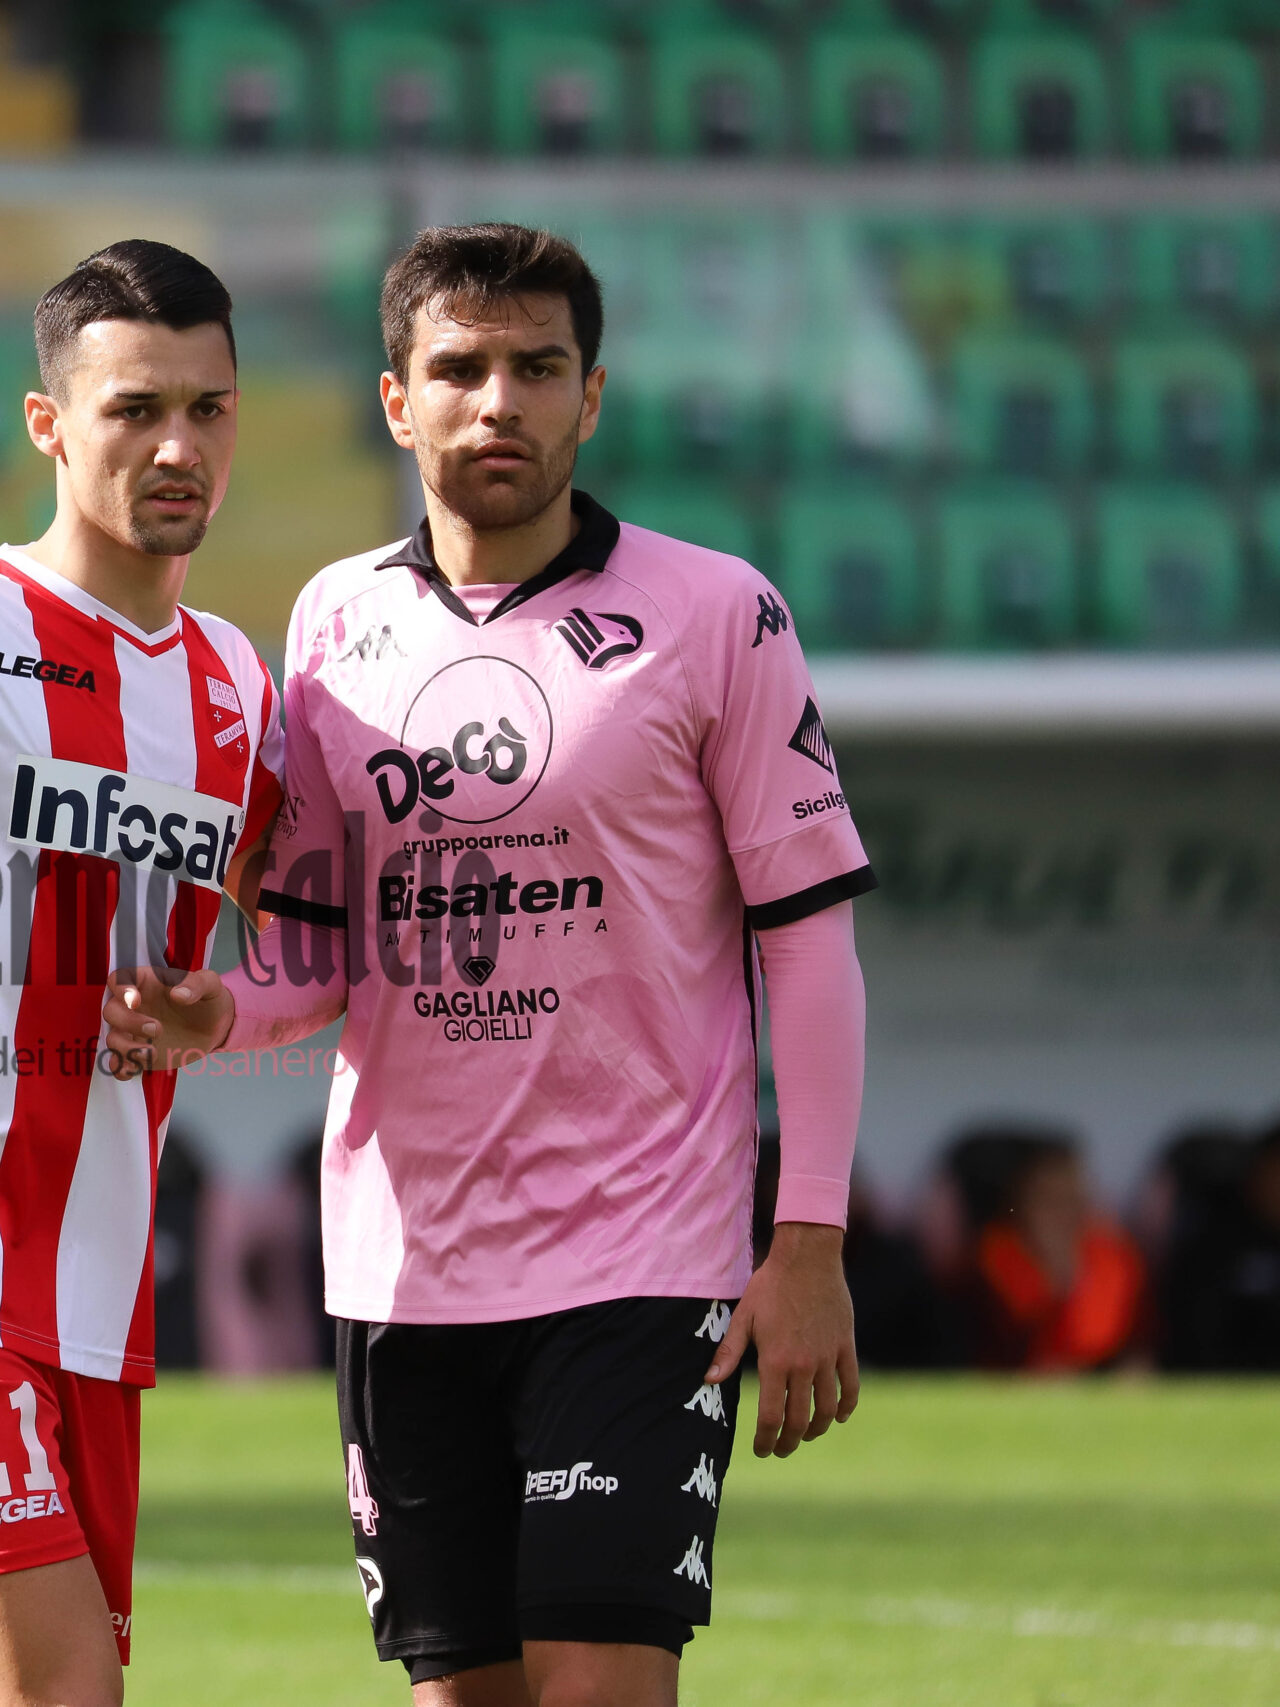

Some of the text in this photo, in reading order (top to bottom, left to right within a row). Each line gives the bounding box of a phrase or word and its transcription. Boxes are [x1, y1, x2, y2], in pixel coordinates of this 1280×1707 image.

[403, 826, 570, 860] gruppoarena.it
[378, 872, 604, 921] Bisaten
[414, 987, 560, 1018] GAGLIANO
[444, 1017, 532, 1041] GIOIELLI
